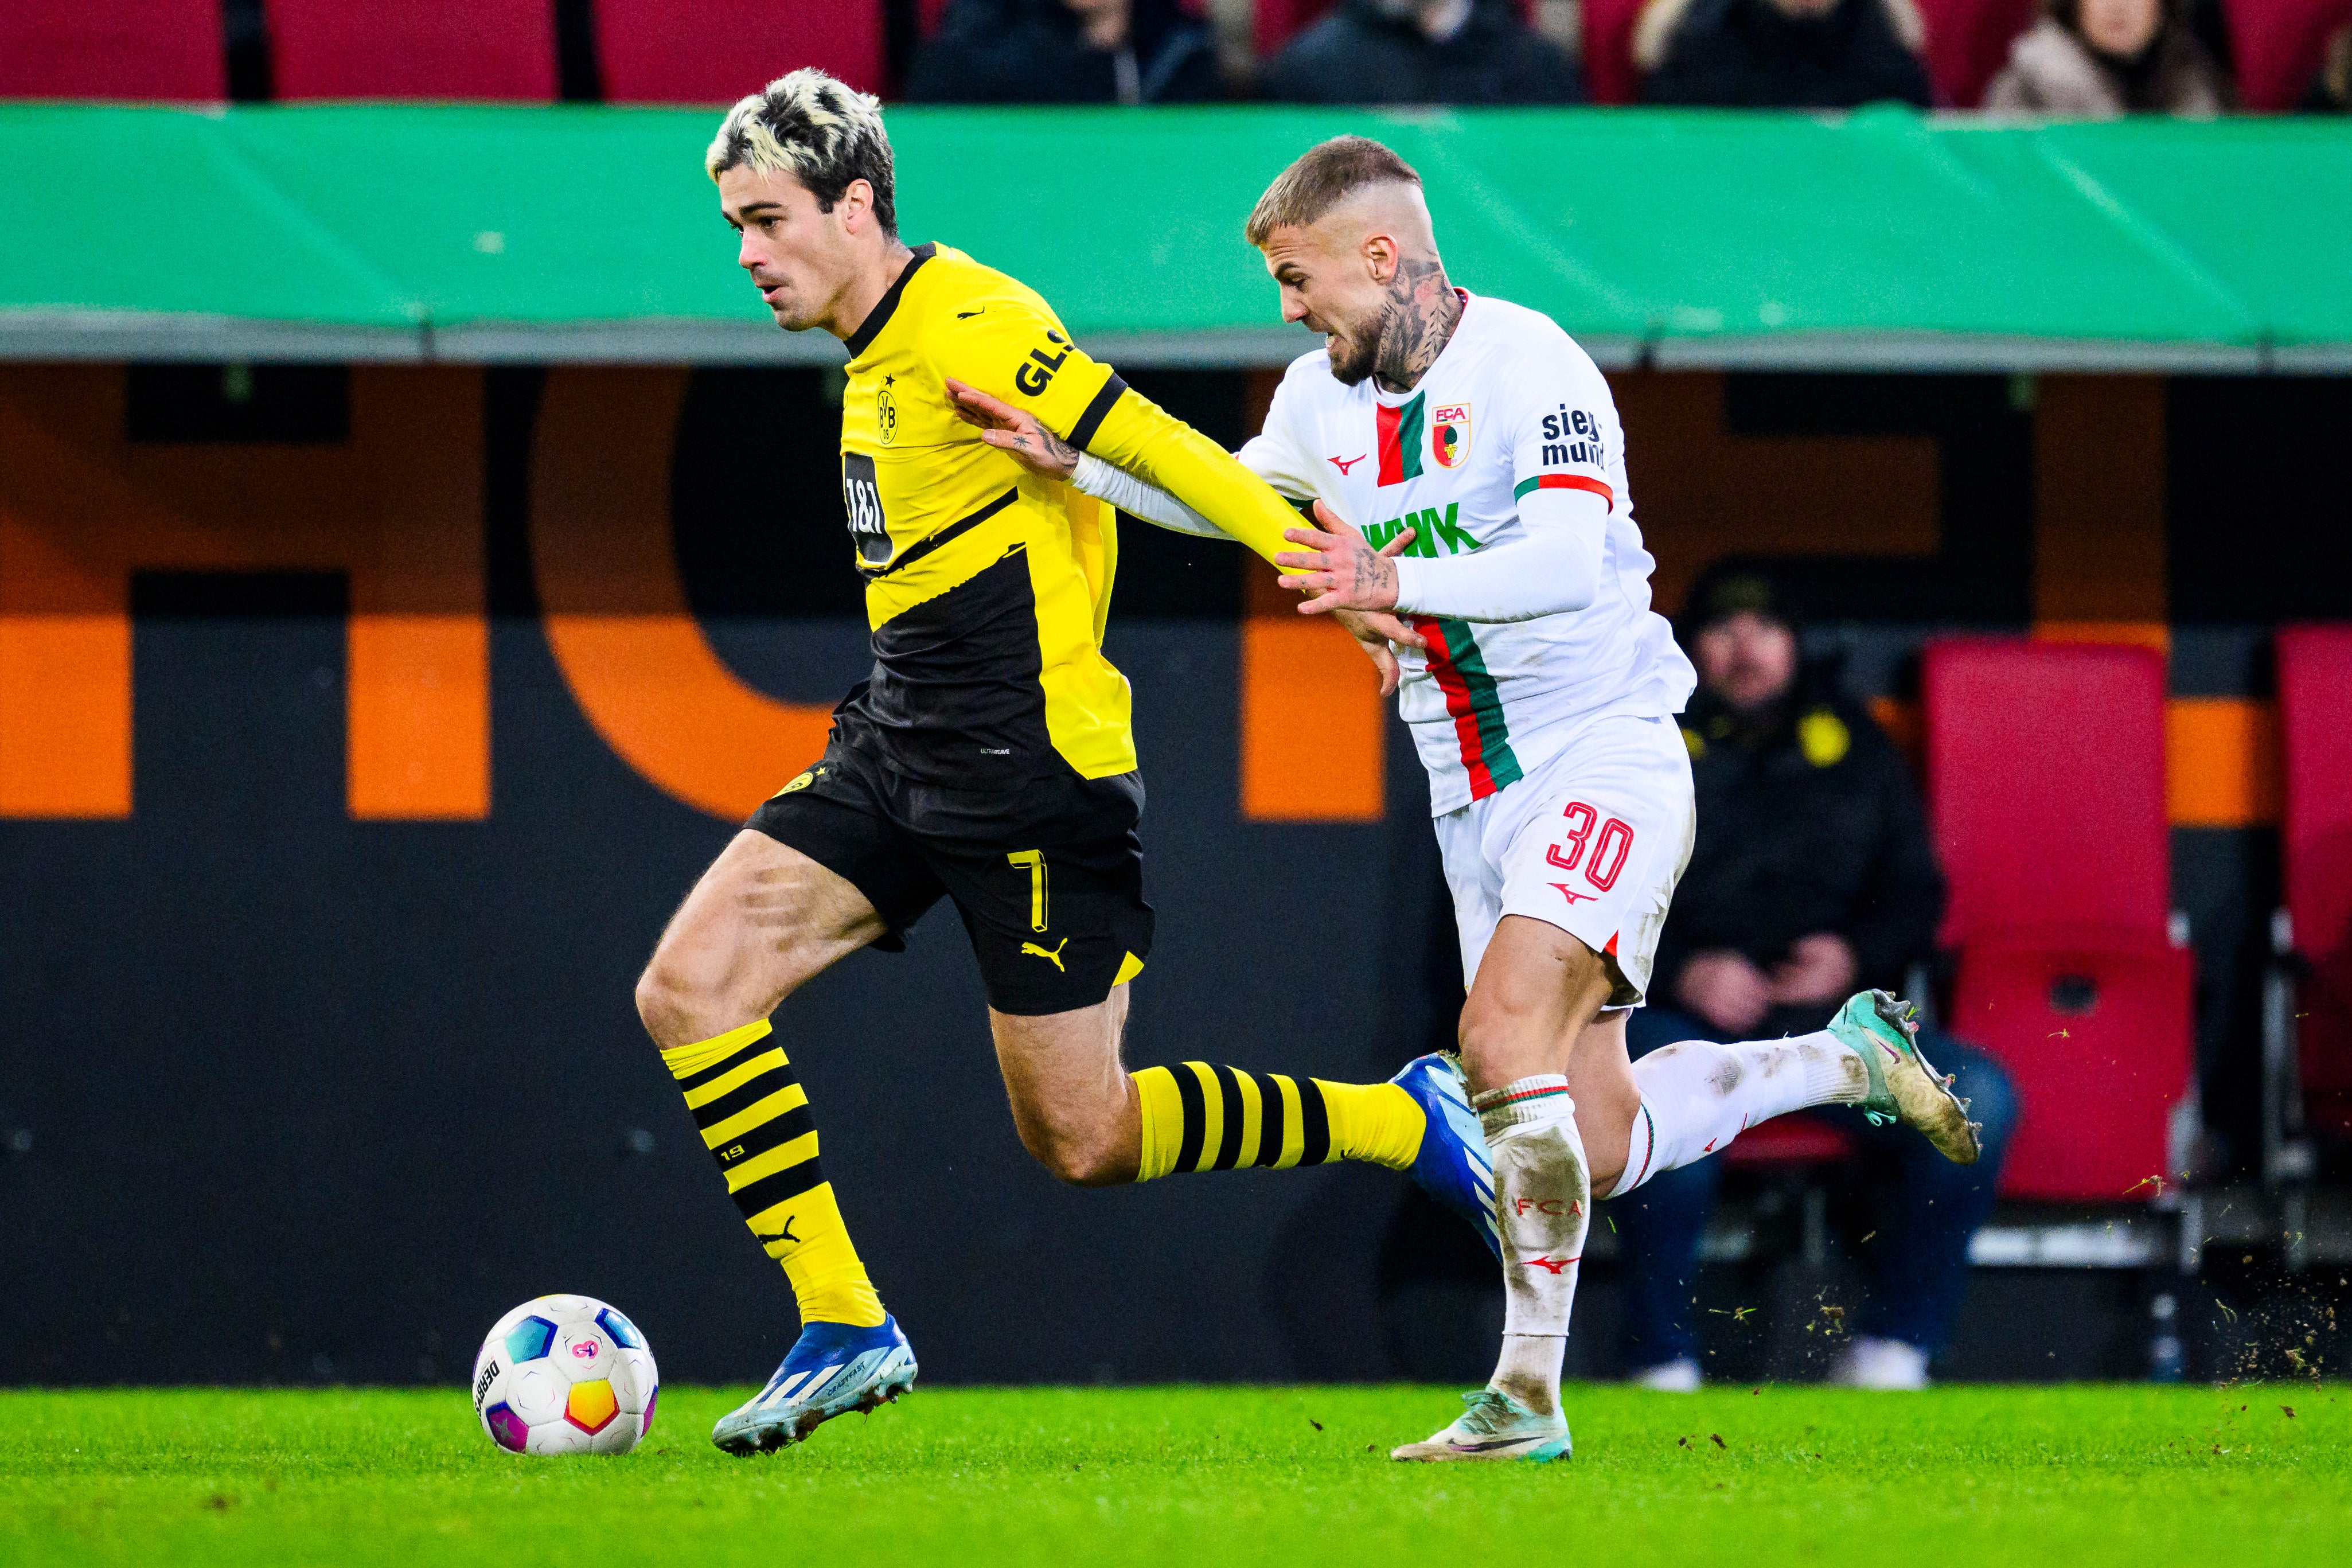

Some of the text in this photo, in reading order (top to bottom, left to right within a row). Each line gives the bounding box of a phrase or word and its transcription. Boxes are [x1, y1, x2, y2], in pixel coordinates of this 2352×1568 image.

[879, 396, 895, 428] BVB
[1436, 407, 1466, 423] FCA
[1361, 502, 1485, 558] WWK
[1546, 801, 1634, 892] 30
[1007, 849, 1048, 933] 7
[721, 1144, 745, 1161] 19
[1517, 1199, 1583, 1218] FCA
